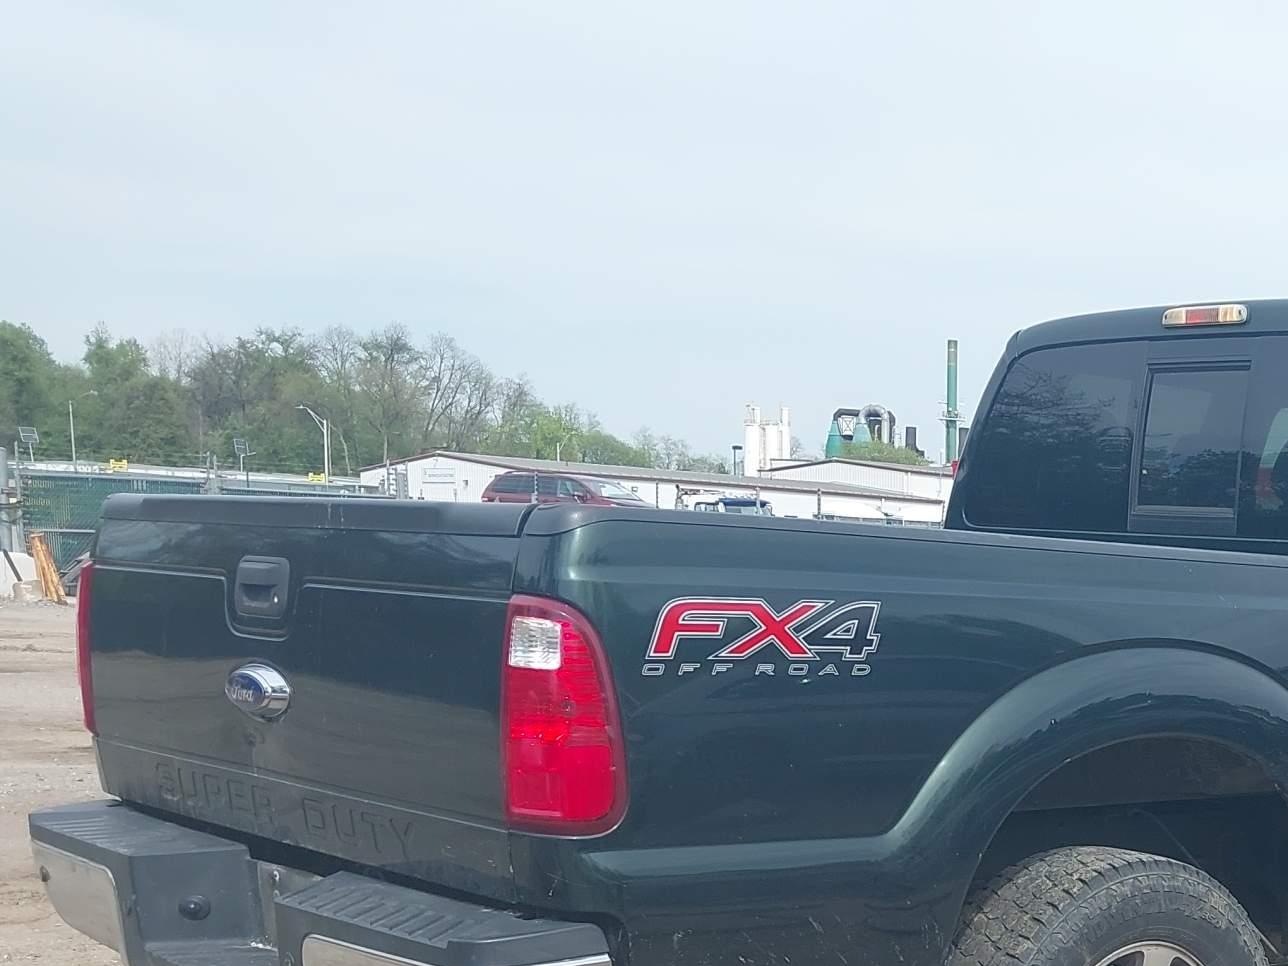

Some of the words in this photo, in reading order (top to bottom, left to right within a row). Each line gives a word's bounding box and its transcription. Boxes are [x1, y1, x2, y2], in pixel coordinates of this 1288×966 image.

[645, 596, 882, 661] FX4
[641, 662, 733, 676] OFF
[754, 662, 872, 676] ROAD
[155, 761, 276, 826] SUPER
[302, 797, 416, 859] DUTY
